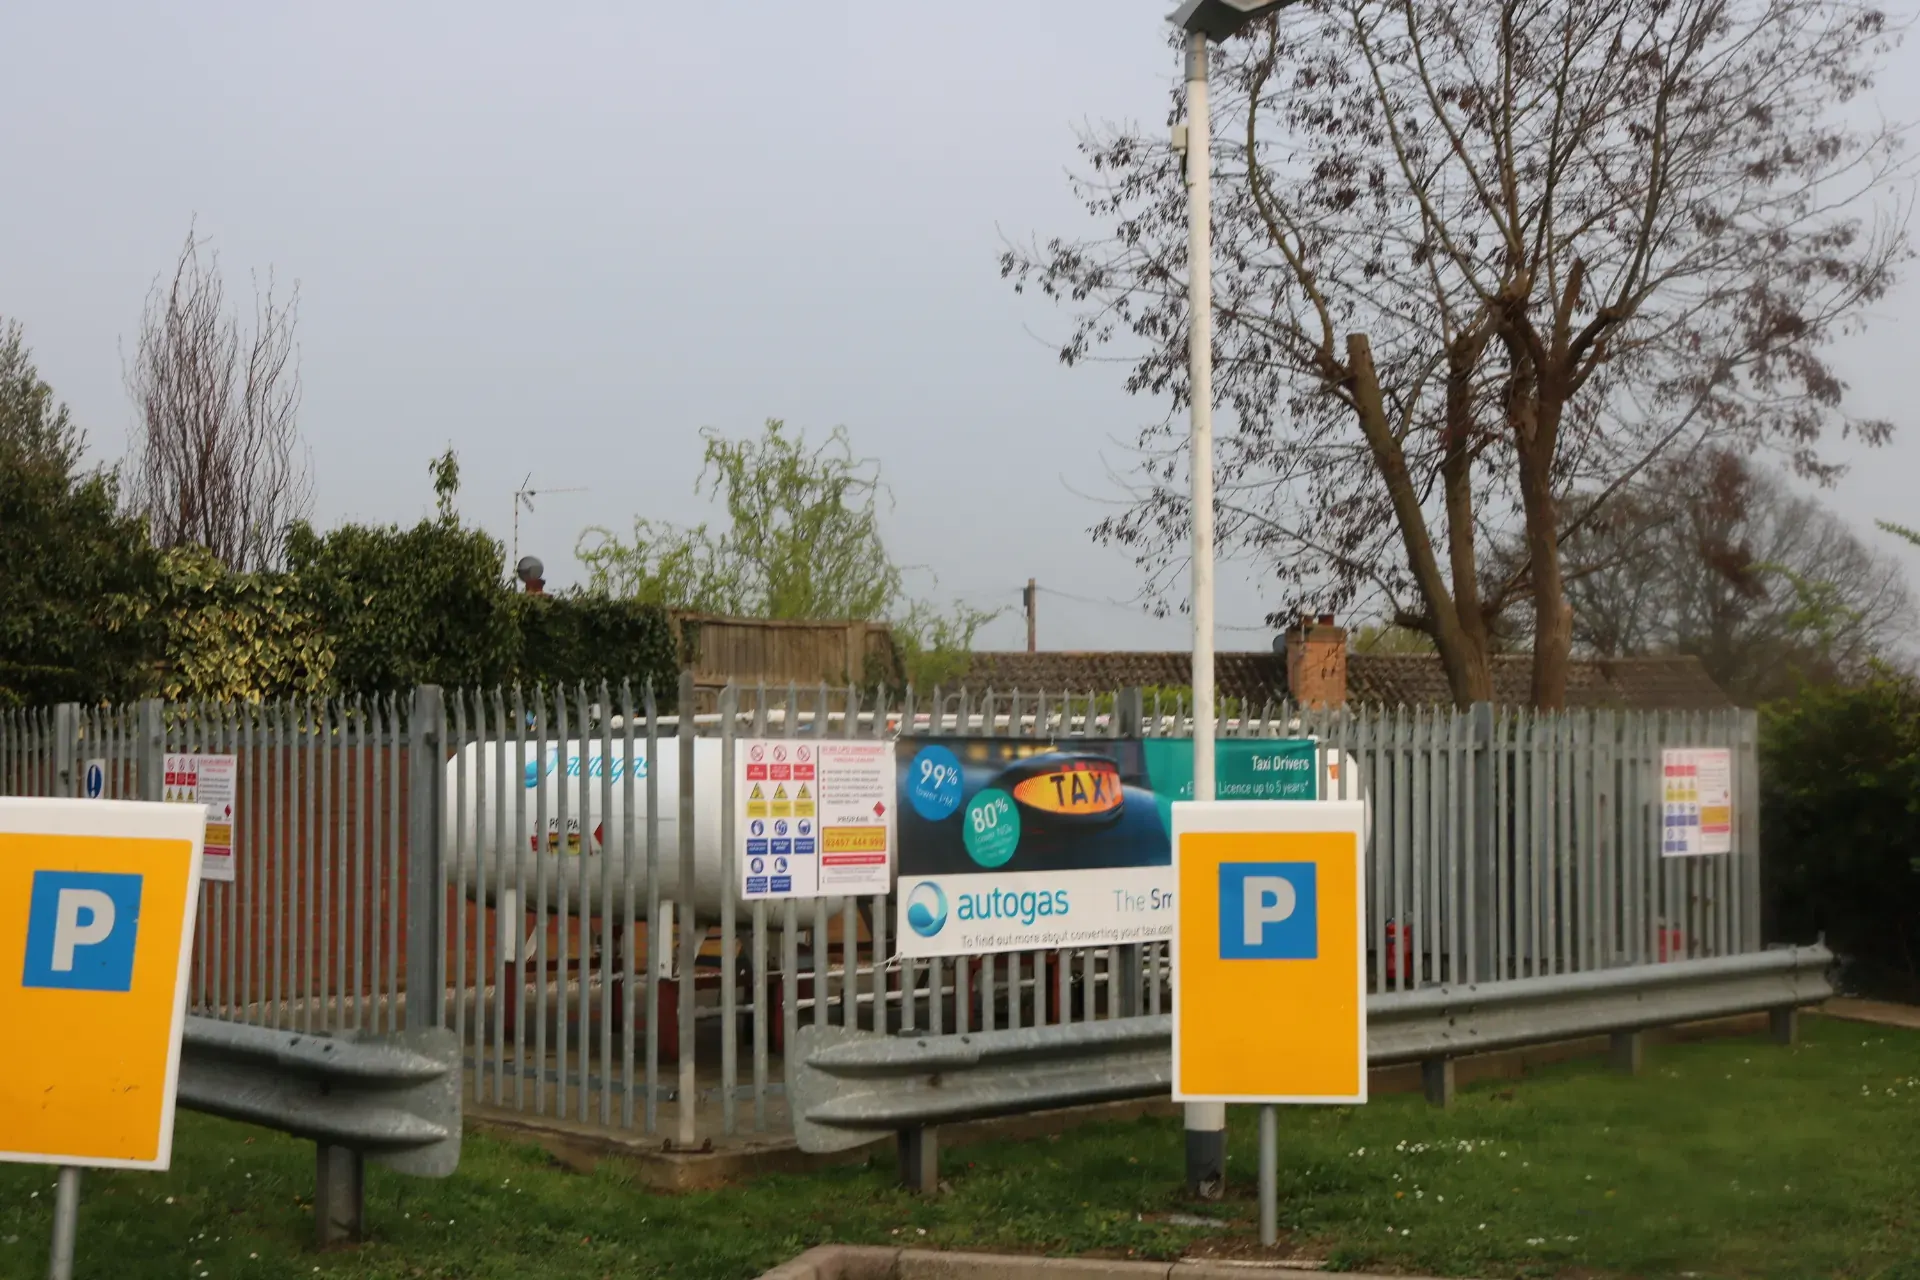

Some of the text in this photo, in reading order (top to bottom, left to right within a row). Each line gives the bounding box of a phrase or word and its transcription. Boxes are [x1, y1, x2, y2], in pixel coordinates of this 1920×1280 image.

[921, 758, 958, 790] 99%
[1252, 755, 1309, 771] Taxi Drivers
[1050, 772, 1116, 806] TAXI
[1219, 780, 1251, 795] Licence
[1253, 784, 1264, 796] up
[1266, 782, 1274, 794] to
[1276, 780, 1282, 794] 5
[971, 797, 1008, 833] 80%
[957, 887, 1070, 926] autogas
[1113, 889, 1145, 912] The
[1243, 876, 1296, 945] P
[51, 888, 116, 972] P
[962, 935, 973, 948] To
[976, 932, 994, 948] find
[997, 933, 1012, 946] out
[1015, 935, 1040, 945] more
[1042, 930, 1068, 944] about
[1071, 926, 1118, 941] converting
[1121, 927, 1140, 940] your
